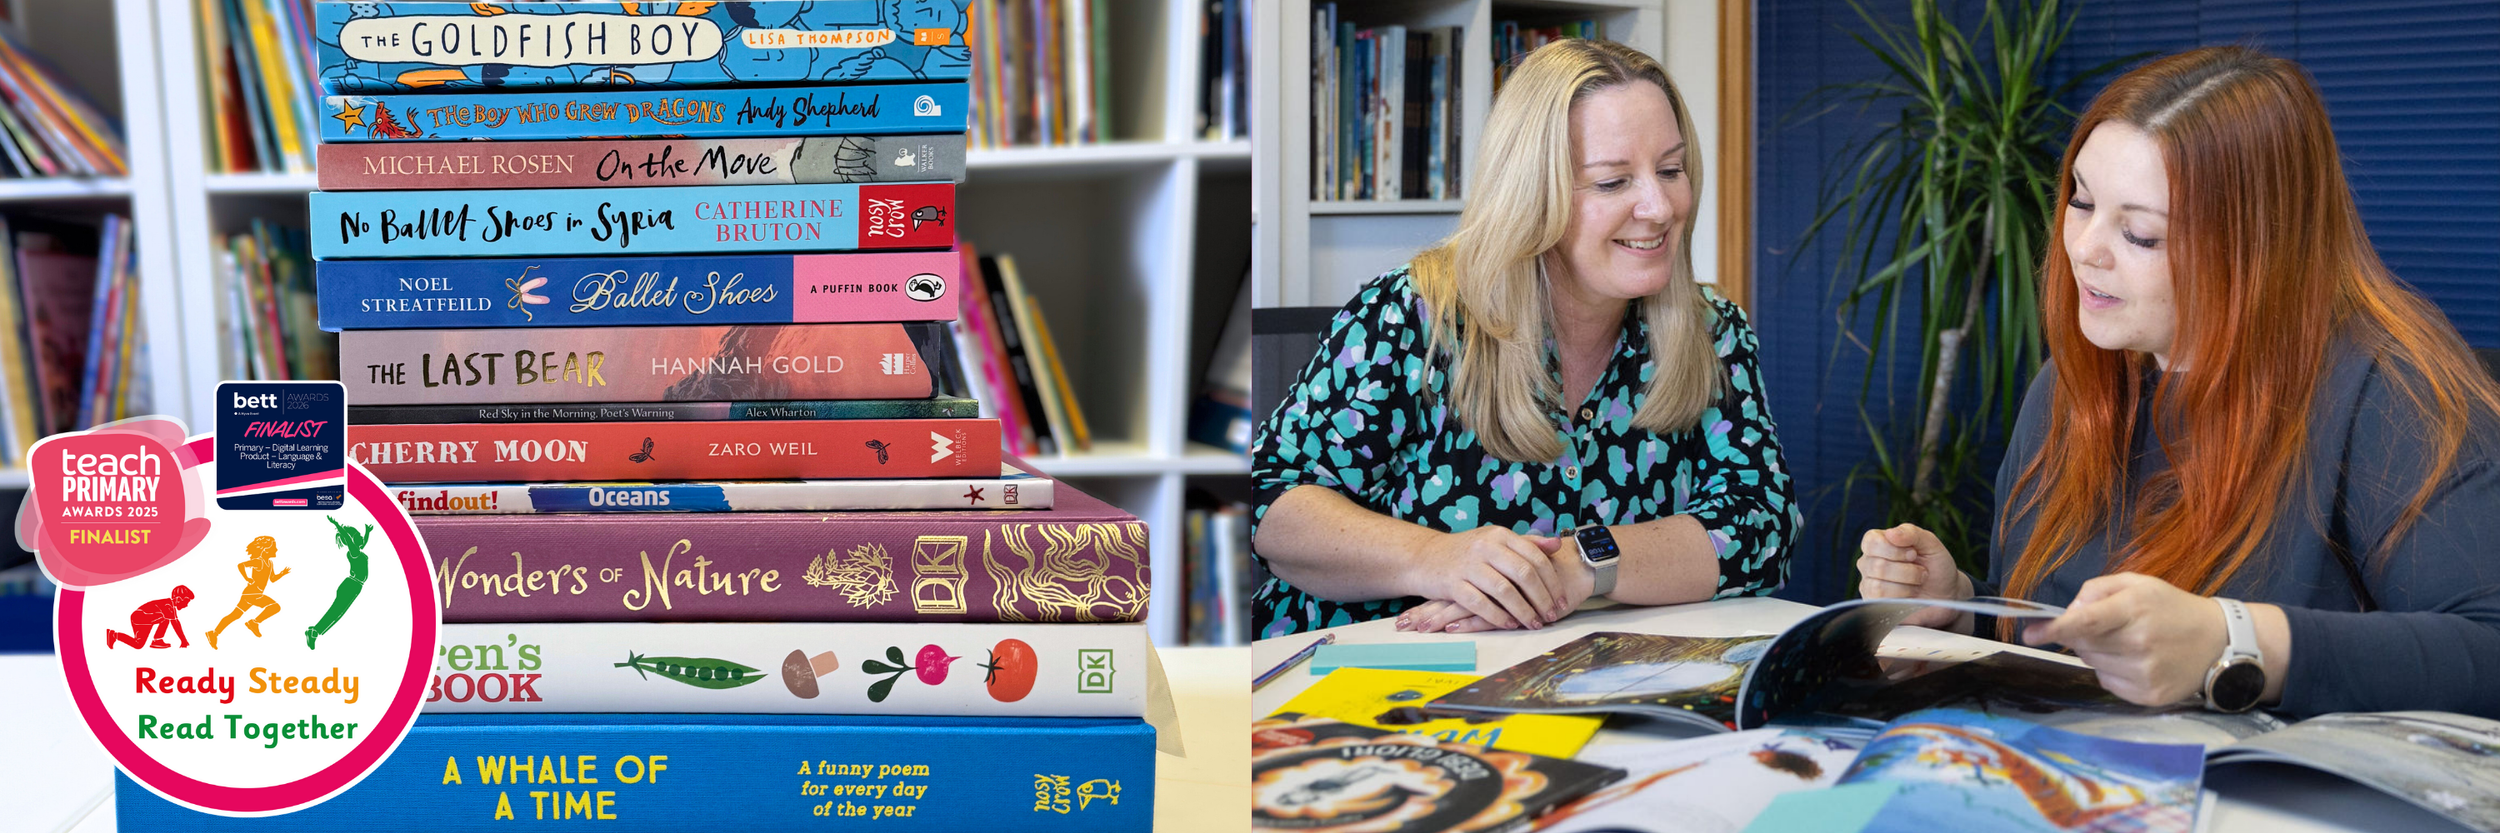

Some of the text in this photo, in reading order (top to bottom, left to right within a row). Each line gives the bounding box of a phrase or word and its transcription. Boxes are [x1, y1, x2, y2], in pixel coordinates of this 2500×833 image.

[361, 21, 699, 59] THE GOLDFISH BOY
[749, 28, 893, 46] LISA THOMPSON
[514, 101, 559, 124] WHO
[624, 97, 726, 126] DRAGONS
[737, 92, 880, 128] Andy Shepherd
[363, 154, 575, 175] MICHAEL ROSEN
[596, 145, 777, 181] On the Move
[920, 144, 935, 173] WALKER BOOKS
[695, 199, 843, 220] CATHERINE
[868, 198, 904, 238] nosy crow
[340, 211, 370, 244] No
[381, 203, 476, 244] Ballet
[482, 205, 557, 242] Shoes
[566, 213, 583, 231] in
[716, 222, 821, 242] BRUTON
[399, 277, 453, 292] NOEL
[569, 270, 778, 314] Ballet Shoes
[810, 283, 898, 294] A PUFFIN BOOK
[361, 297, 492, 312] STREATFEILD
[367, 349, 606, 388] THE LAST BEAR
[652, 355, 844, 375] HANNAH GOLD
[479, 409, 499, 419] Red
[501, 408, 519, 420] Sky
[521, 408, 531, 418] in
[533, 408, 550, 418] the
[632, 407, 675, 419] Warning
[745, 406, 816, 417] Alex Wharton
[349, 440, 588, 466] CHERRY MOON
[708, 442, 818, 456] ZARO WEIL
[588, 487, 670, 507] Oceans
[1004, 484, 1016, 503] DK
[600, 568, 623, 582] OF
[623, 538, 782, 611] Nature
[914, 540, 961, 608] DK
[1086, 654, 1106, 687] DK
[442, 755, 668, 785] A WHALE OF
[797, 760, 930, 780] A funny poem
[801, 781, 928, 800] for every day
[1034, 774, 1070, 815] nosy crow
[495, 790, 617, 820] A TIME
[813, 801, 916, 820] of the year
